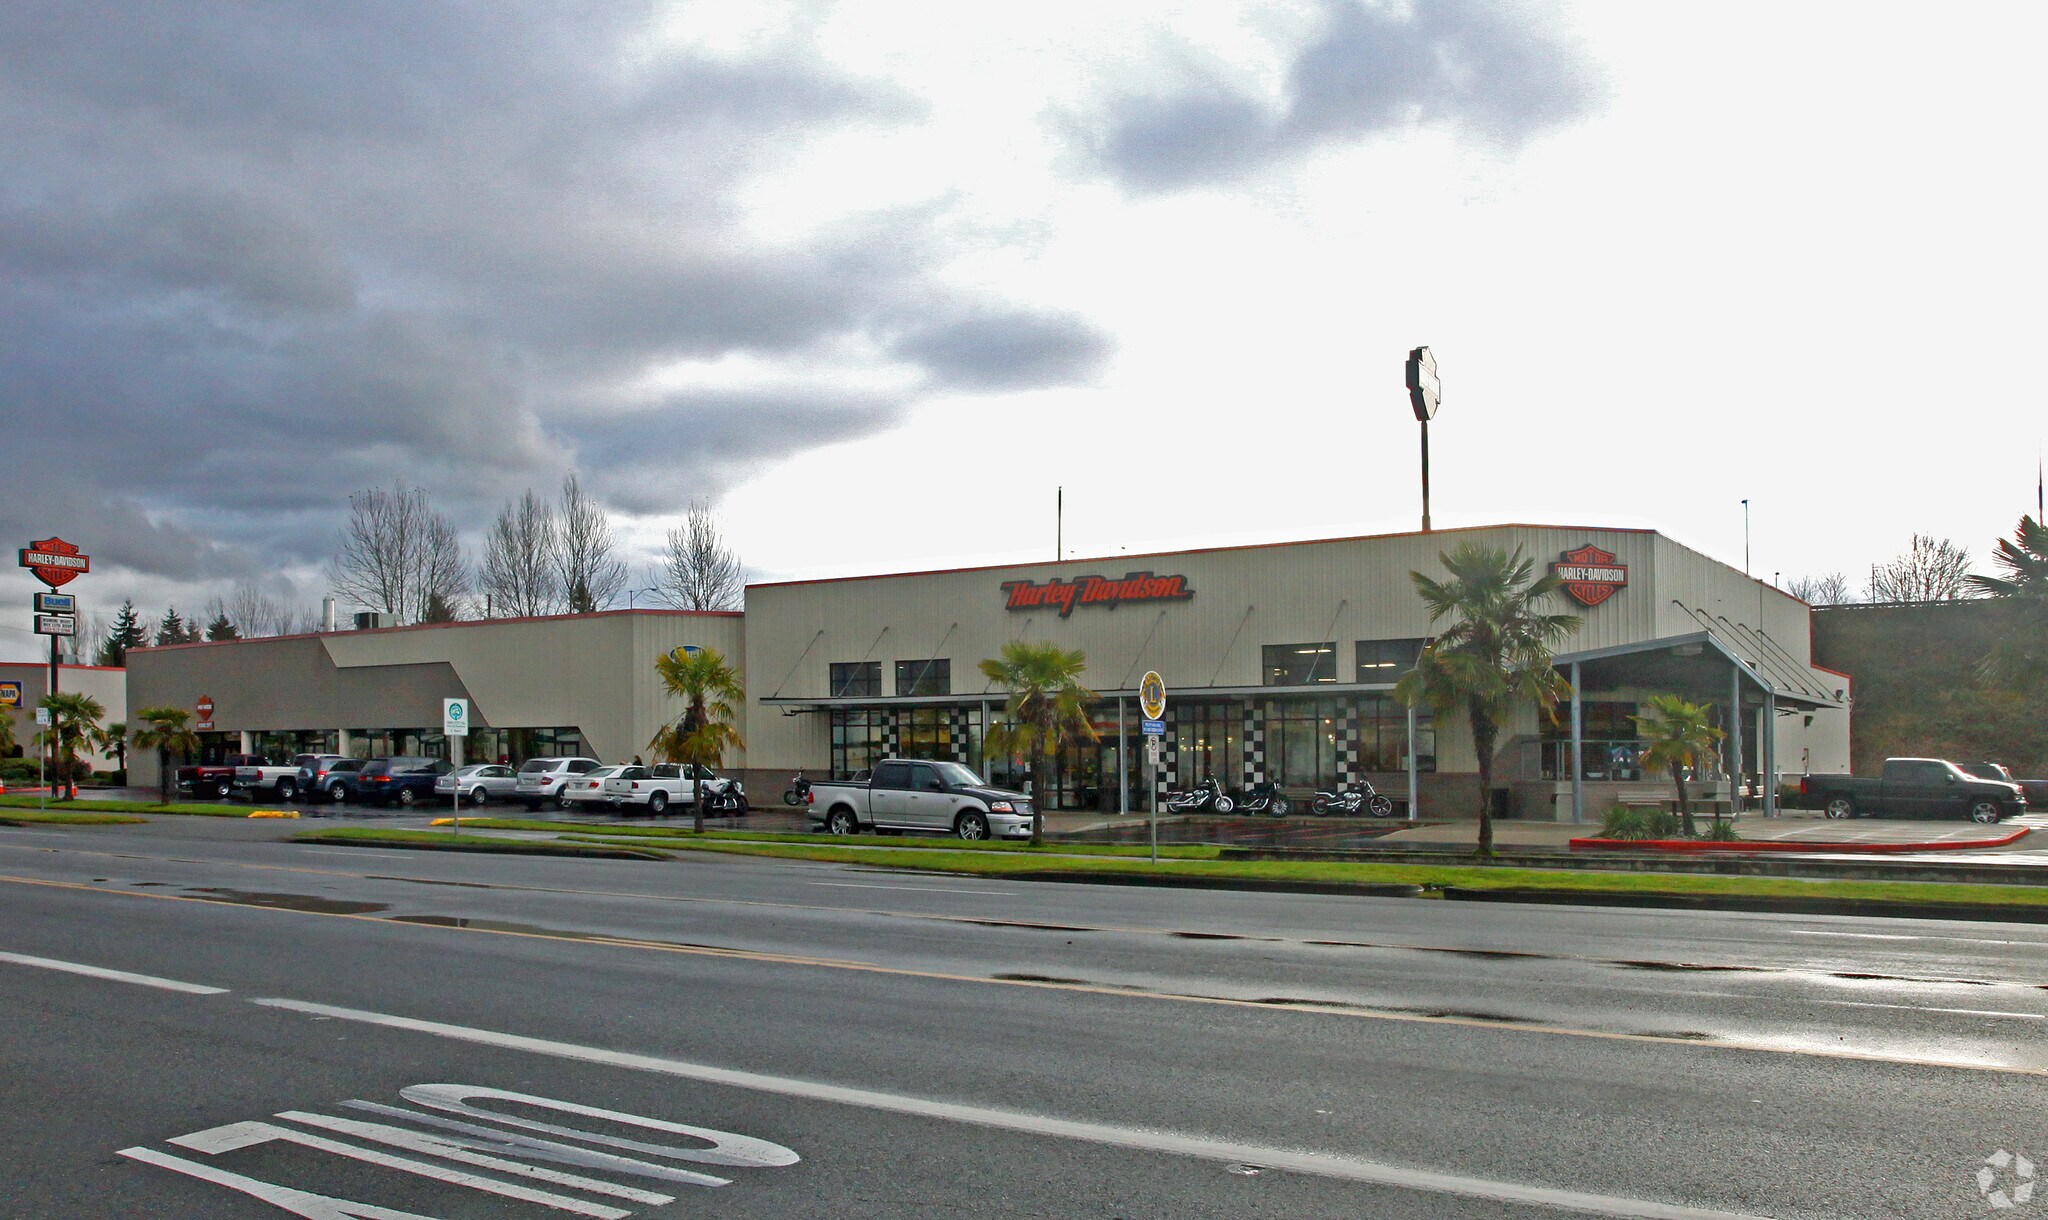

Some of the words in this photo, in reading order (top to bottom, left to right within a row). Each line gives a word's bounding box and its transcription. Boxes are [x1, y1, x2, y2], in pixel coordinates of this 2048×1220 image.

[28, 552, 86, 569] HARLEY-DAVIDSON
[1558, 567, 1624, 582] HARLEY-DAVIDSON
[44, 596, 71, 607] Buell
[1002, 573, 1188, 615] Harley-Davidson
[1, 689, 16, 699] NAPA
